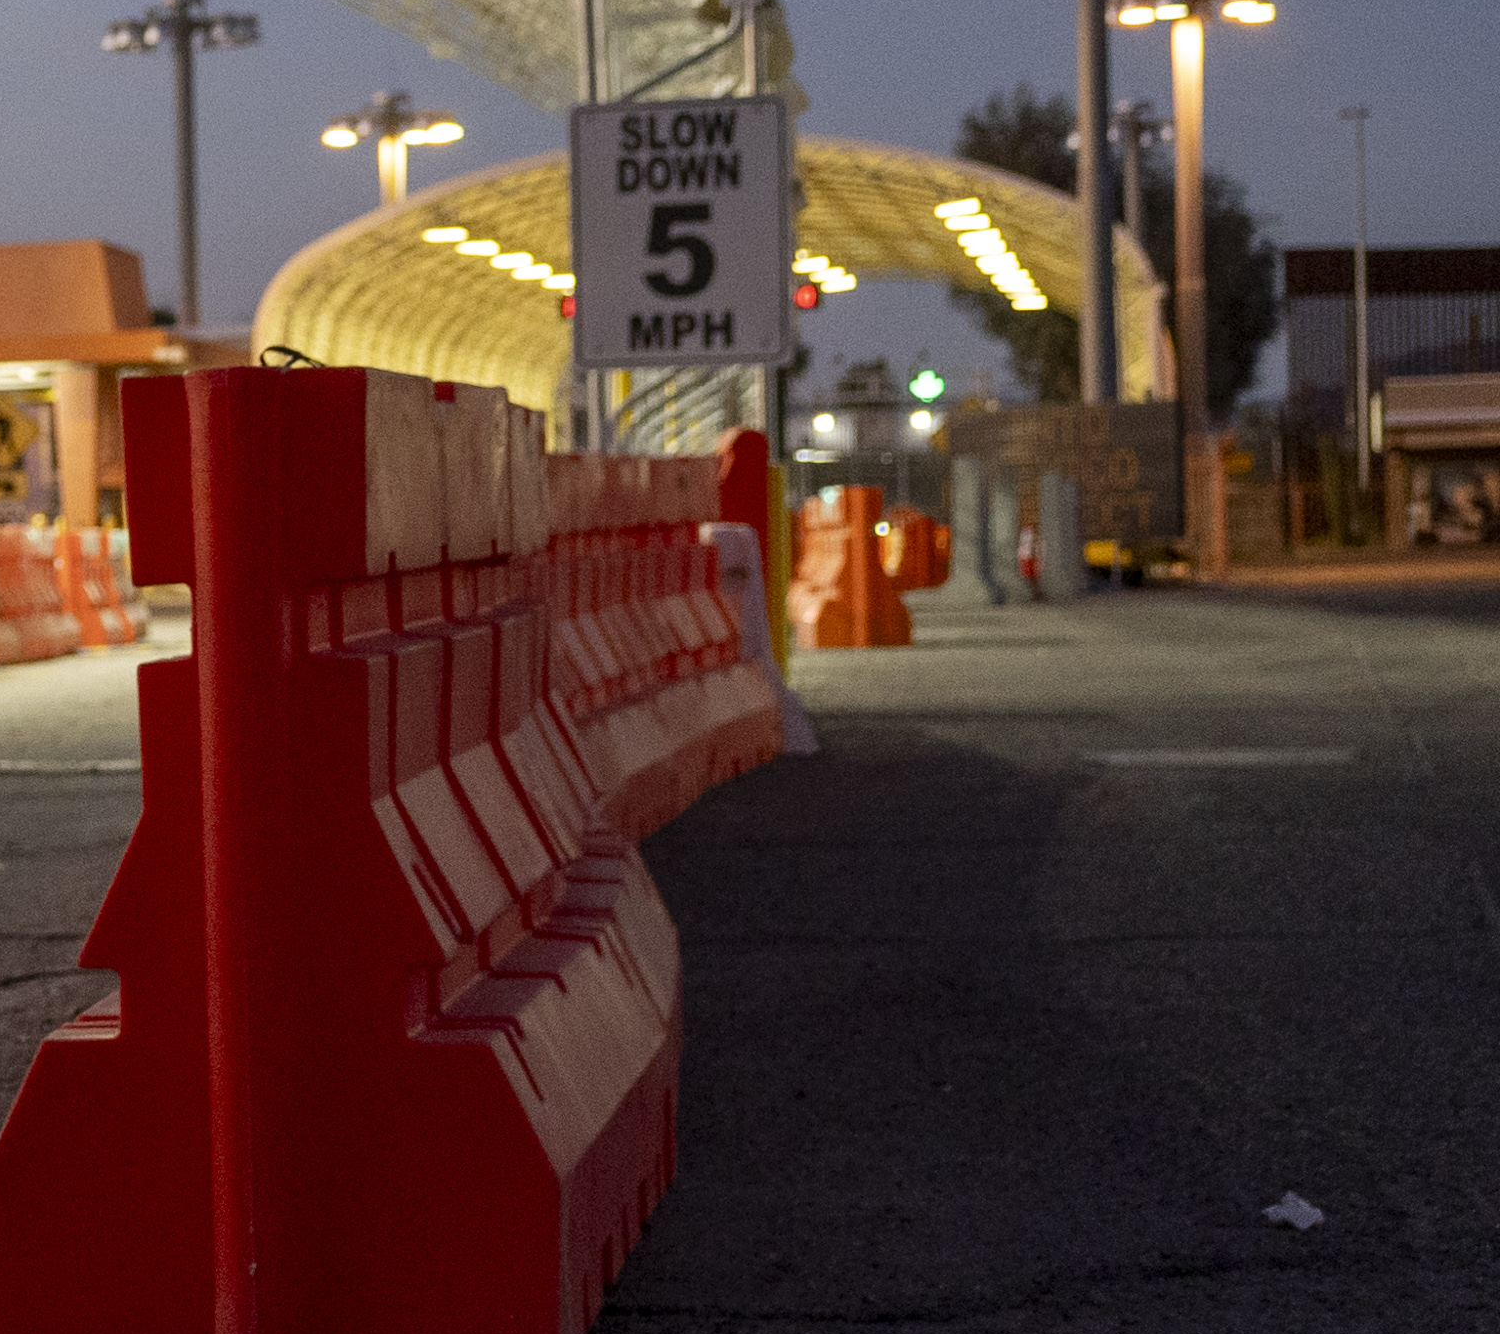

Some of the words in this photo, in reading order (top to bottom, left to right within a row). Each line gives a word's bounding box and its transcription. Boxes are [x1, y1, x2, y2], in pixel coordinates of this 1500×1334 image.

[619, 111, 738, 152] SLOW
[616, 153, 743, 194] DOWN
[646, 203, 715, 297] 5
[628, 311, 735, 352] MPH
